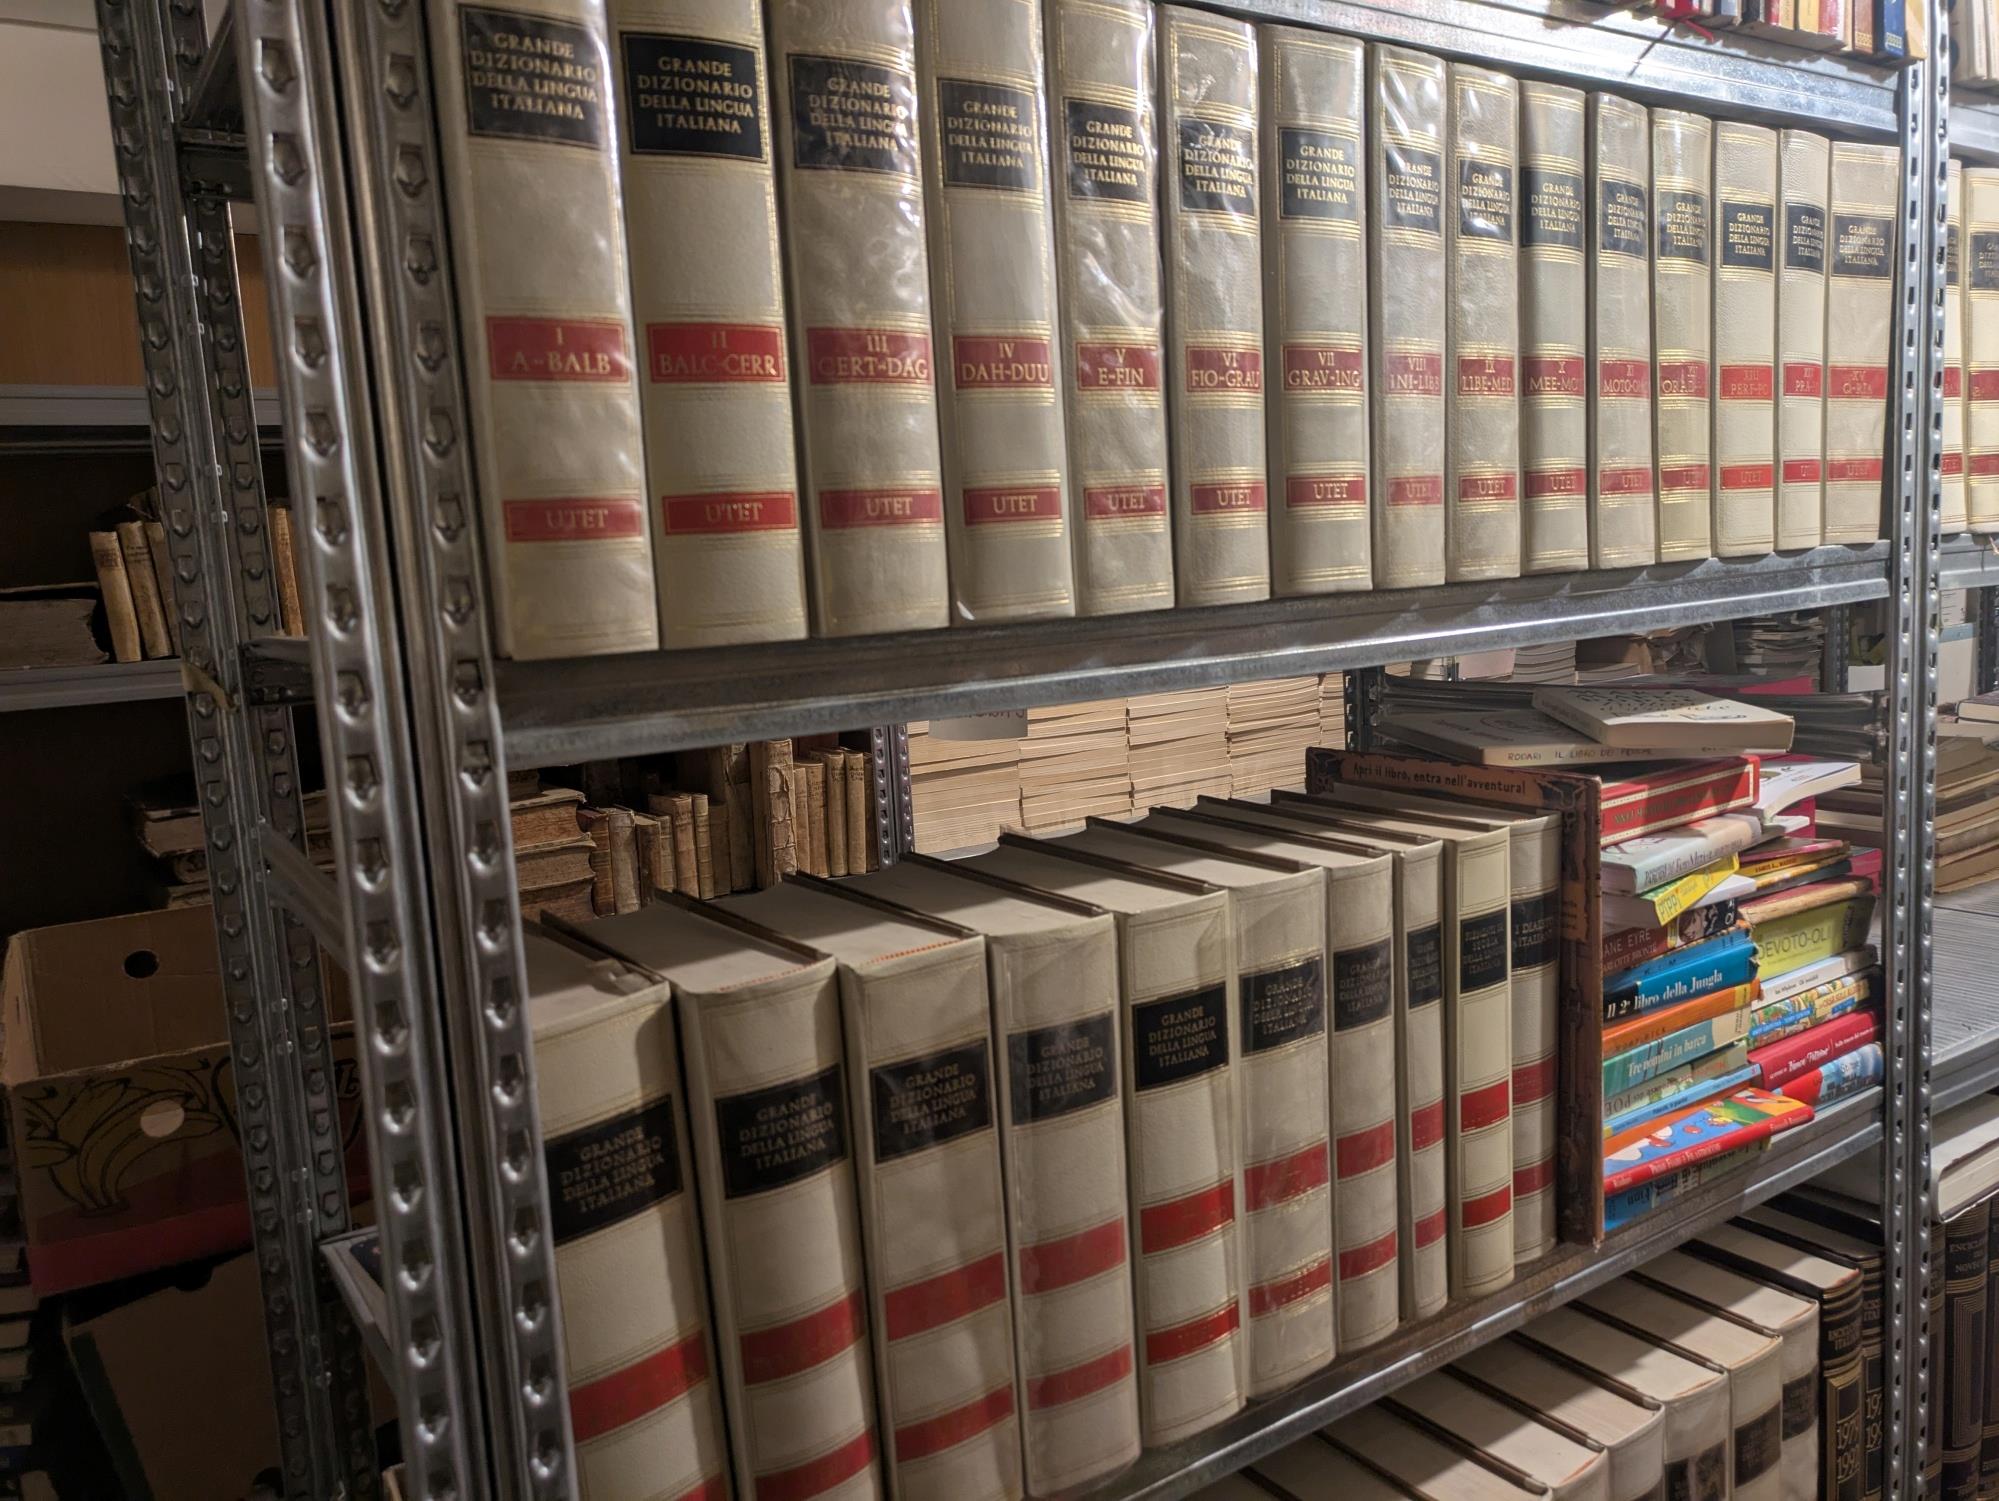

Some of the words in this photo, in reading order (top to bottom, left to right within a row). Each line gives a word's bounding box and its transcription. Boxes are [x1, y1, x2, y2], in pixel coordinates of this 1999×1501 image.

[494, 33, 574, 58] GRANDE
[472, 50, 596, 82] DIZIONARIO
[658, 57, 732, 76] GRANDE
[472, 72, 529, 92] DELLA
[534, 79, 597, 102] LINGUA
[637, 75, 753, 98] DIZIONARIO
[827, 77, 891, 97] GRANDE
[491, 93, 584, 120] ITALIANA
[640, 94, 690, 110] DELLA
[695, 99, 754, 117] LINGUA
[808, 95, 909, 119] DIZIONARIO
[963, 101, 1018, 118] GRANDE
[656, 114, 742, 133] ITALIANA
[810, 113, 855, 127] DELLA
[947, 117, 1032, 137] DIZIONARIO
[1086, 121, 1132, 138] GRANDE
[826, 131, 897, 150] ITALIANA
[948, 134, 987, 148] DELLA
[990, 138, 1032, 154] LINGUA
[1073, 136, 1144, 156] DIZIONARIO
[961, 152, 1024, 168] ITALIANA
[1073, 152, 1107, 165] DELLA
[1109, 155, 1145, 171] LINGUA
[1300, 146, 1344, 160] GRANDE
[1085, 168, 1137, 186] ITALIANA
[1287, 160, 1355, 177] DIZIONARIO
[1402, 161, 1432, 176] RANDE
[1287, 174, 1319, 185] DELLA
[1322, 176, 1354, 191] LINGUA
[1297, 188, 1347, 204] ITALIANA
[710, 331, 727, 350] II
[867, 335, 887, 352] III
[999, 343, 1015, 359] IV
[1116, 349, 1127, 364] V
[1222, 352, 1238, 368] VI
[1318, 351, 1335, 366] VII
[659, 353, 777, 376] BALC-CERR
[819, 356, 928, 378] CERT-DAG
[962, 362, 1048, 381] DAH-DUU
[1098, 367, 1144, 385] E-FIN
[1191, 369, 1260, 387] FIO-GRAU
[1288, 370, 1361, 386] GRAV-ING
[1216, 489, 1252, 506] UTET
[1313, 483, 1349, 499] UTET
[1478, 481, 1506, 495] UTET
[864, 497, 913, 516] UTET
[992, 495, 1039, 514] UTET
[1106, 492, 1146, 511] UTET
[546, 508, 608, 530] UTET
[705, 503, 764, 523] UTET
[1354, 763, 1372, 777] Apri
[1375, 765, 1381, 775] il
[1385, 766, 1410, 781] libro,
[1414, 772, 1441, 783] entra
[1445, 773, 1526, 794] nell'avventura!
[1634, 993, 1659, 1010] libro
[1663, 981, 1688, 1000] della
[1690, 969, 1723, 994] Jungla
[1674, 1044, 1684, 1056] in
[1684, 1035, 1707, 1052] barca
